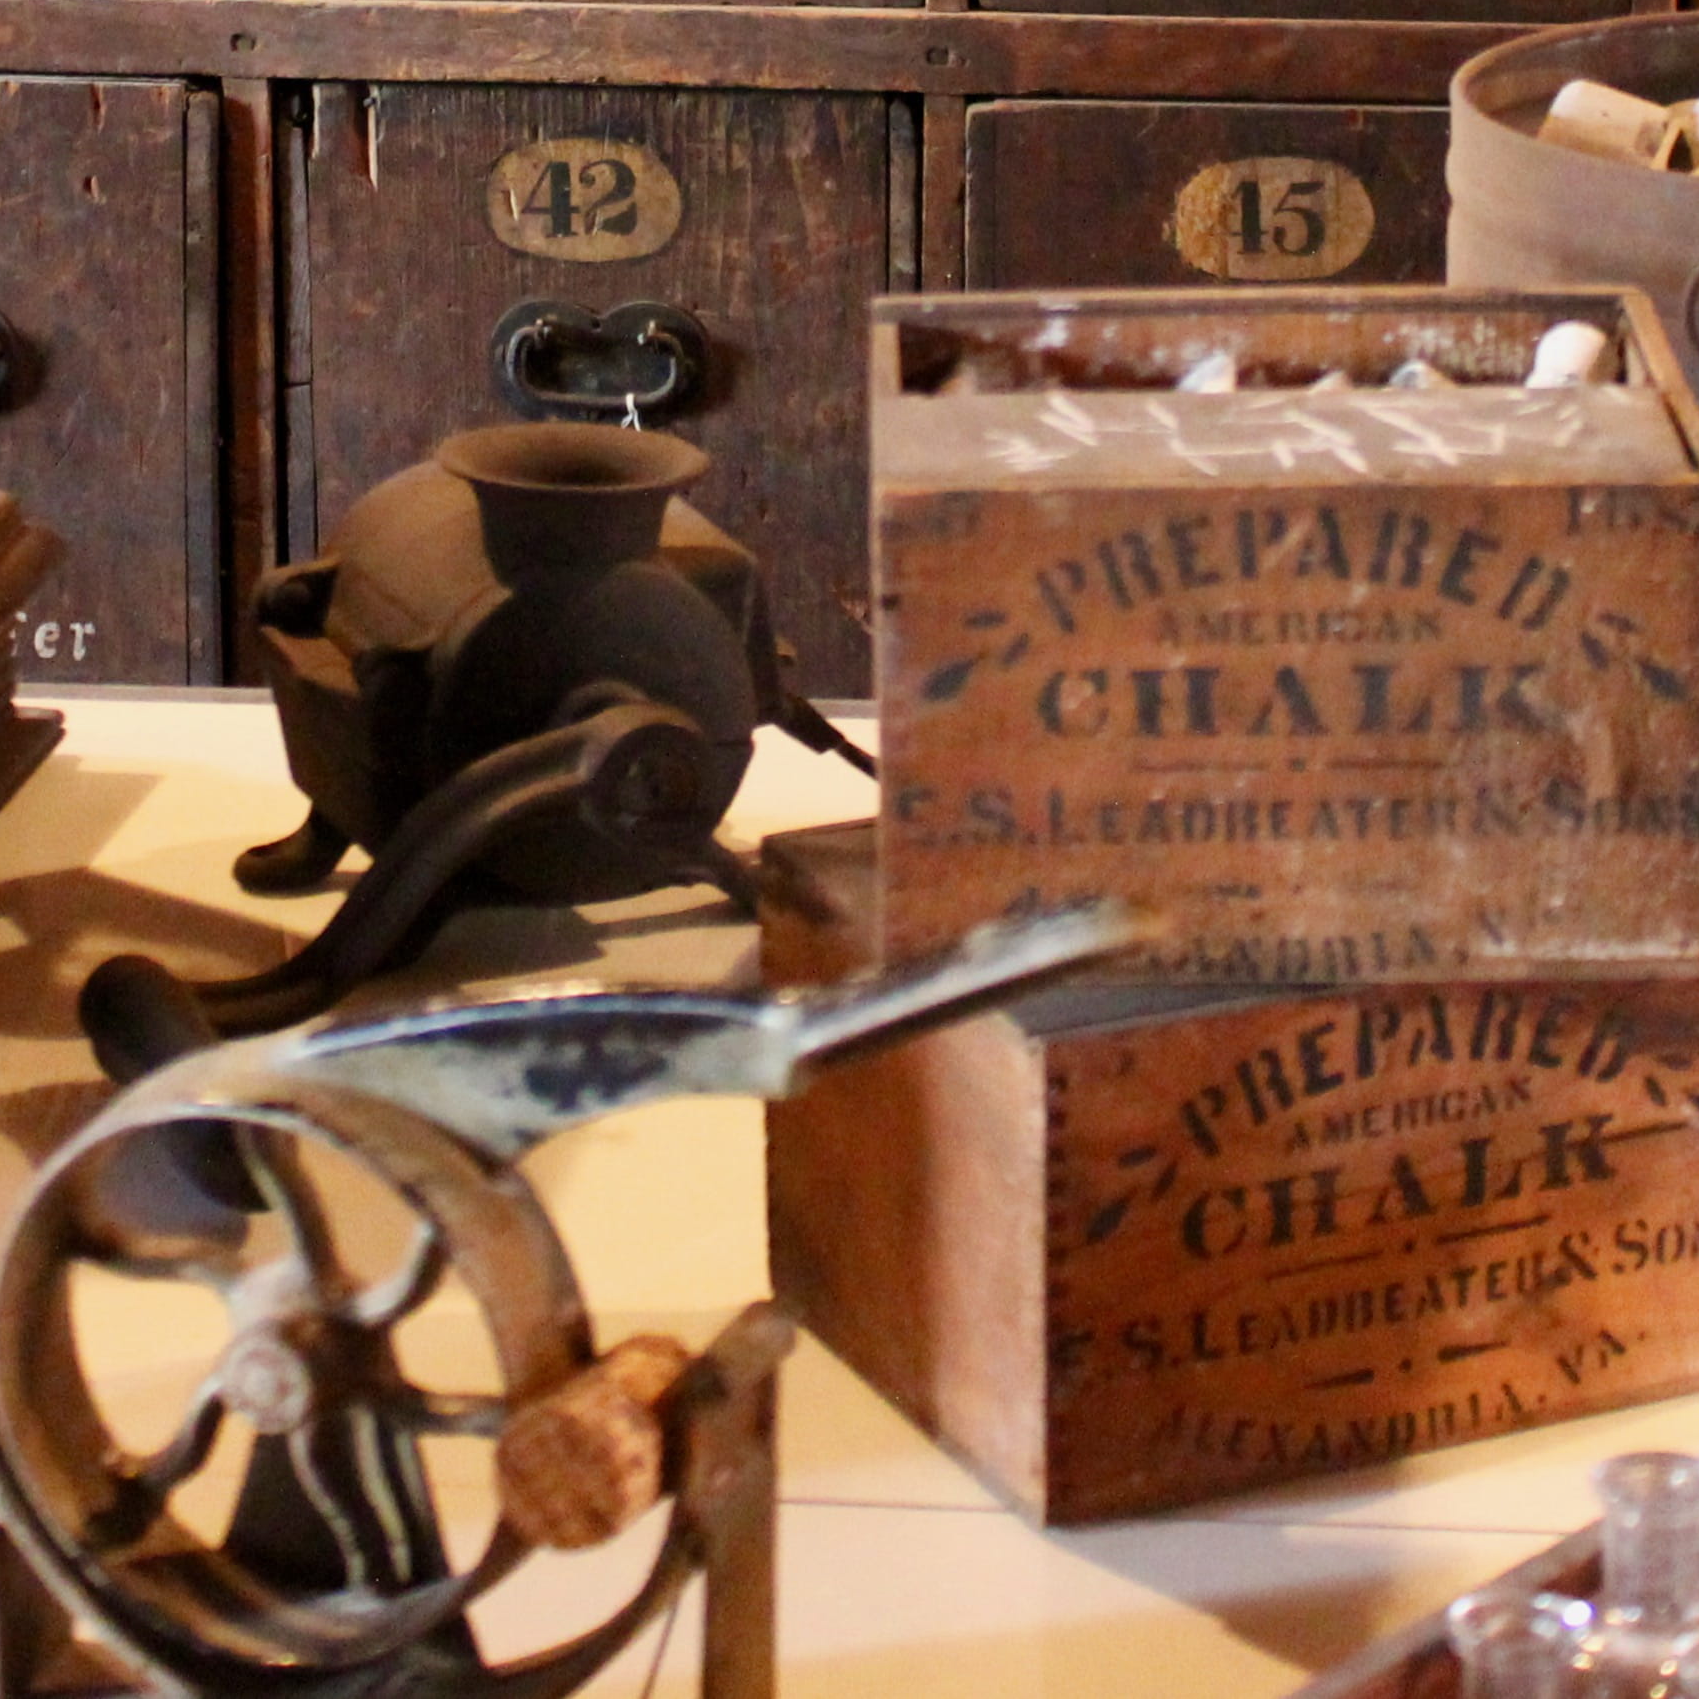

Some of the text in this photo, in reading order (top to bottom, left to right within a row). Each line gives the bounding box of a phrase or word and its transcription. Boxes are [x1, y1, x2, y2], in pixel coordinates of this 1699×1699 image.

[519, 157, 639, 236] 42
[1034, 504, 1574, 636] PREPARED
[1036, 663, 1559, 742] CHALK
[1178, 987, 1627, 1158] PREPARED
[1181, 1113, 1618, 1261] CHALK
